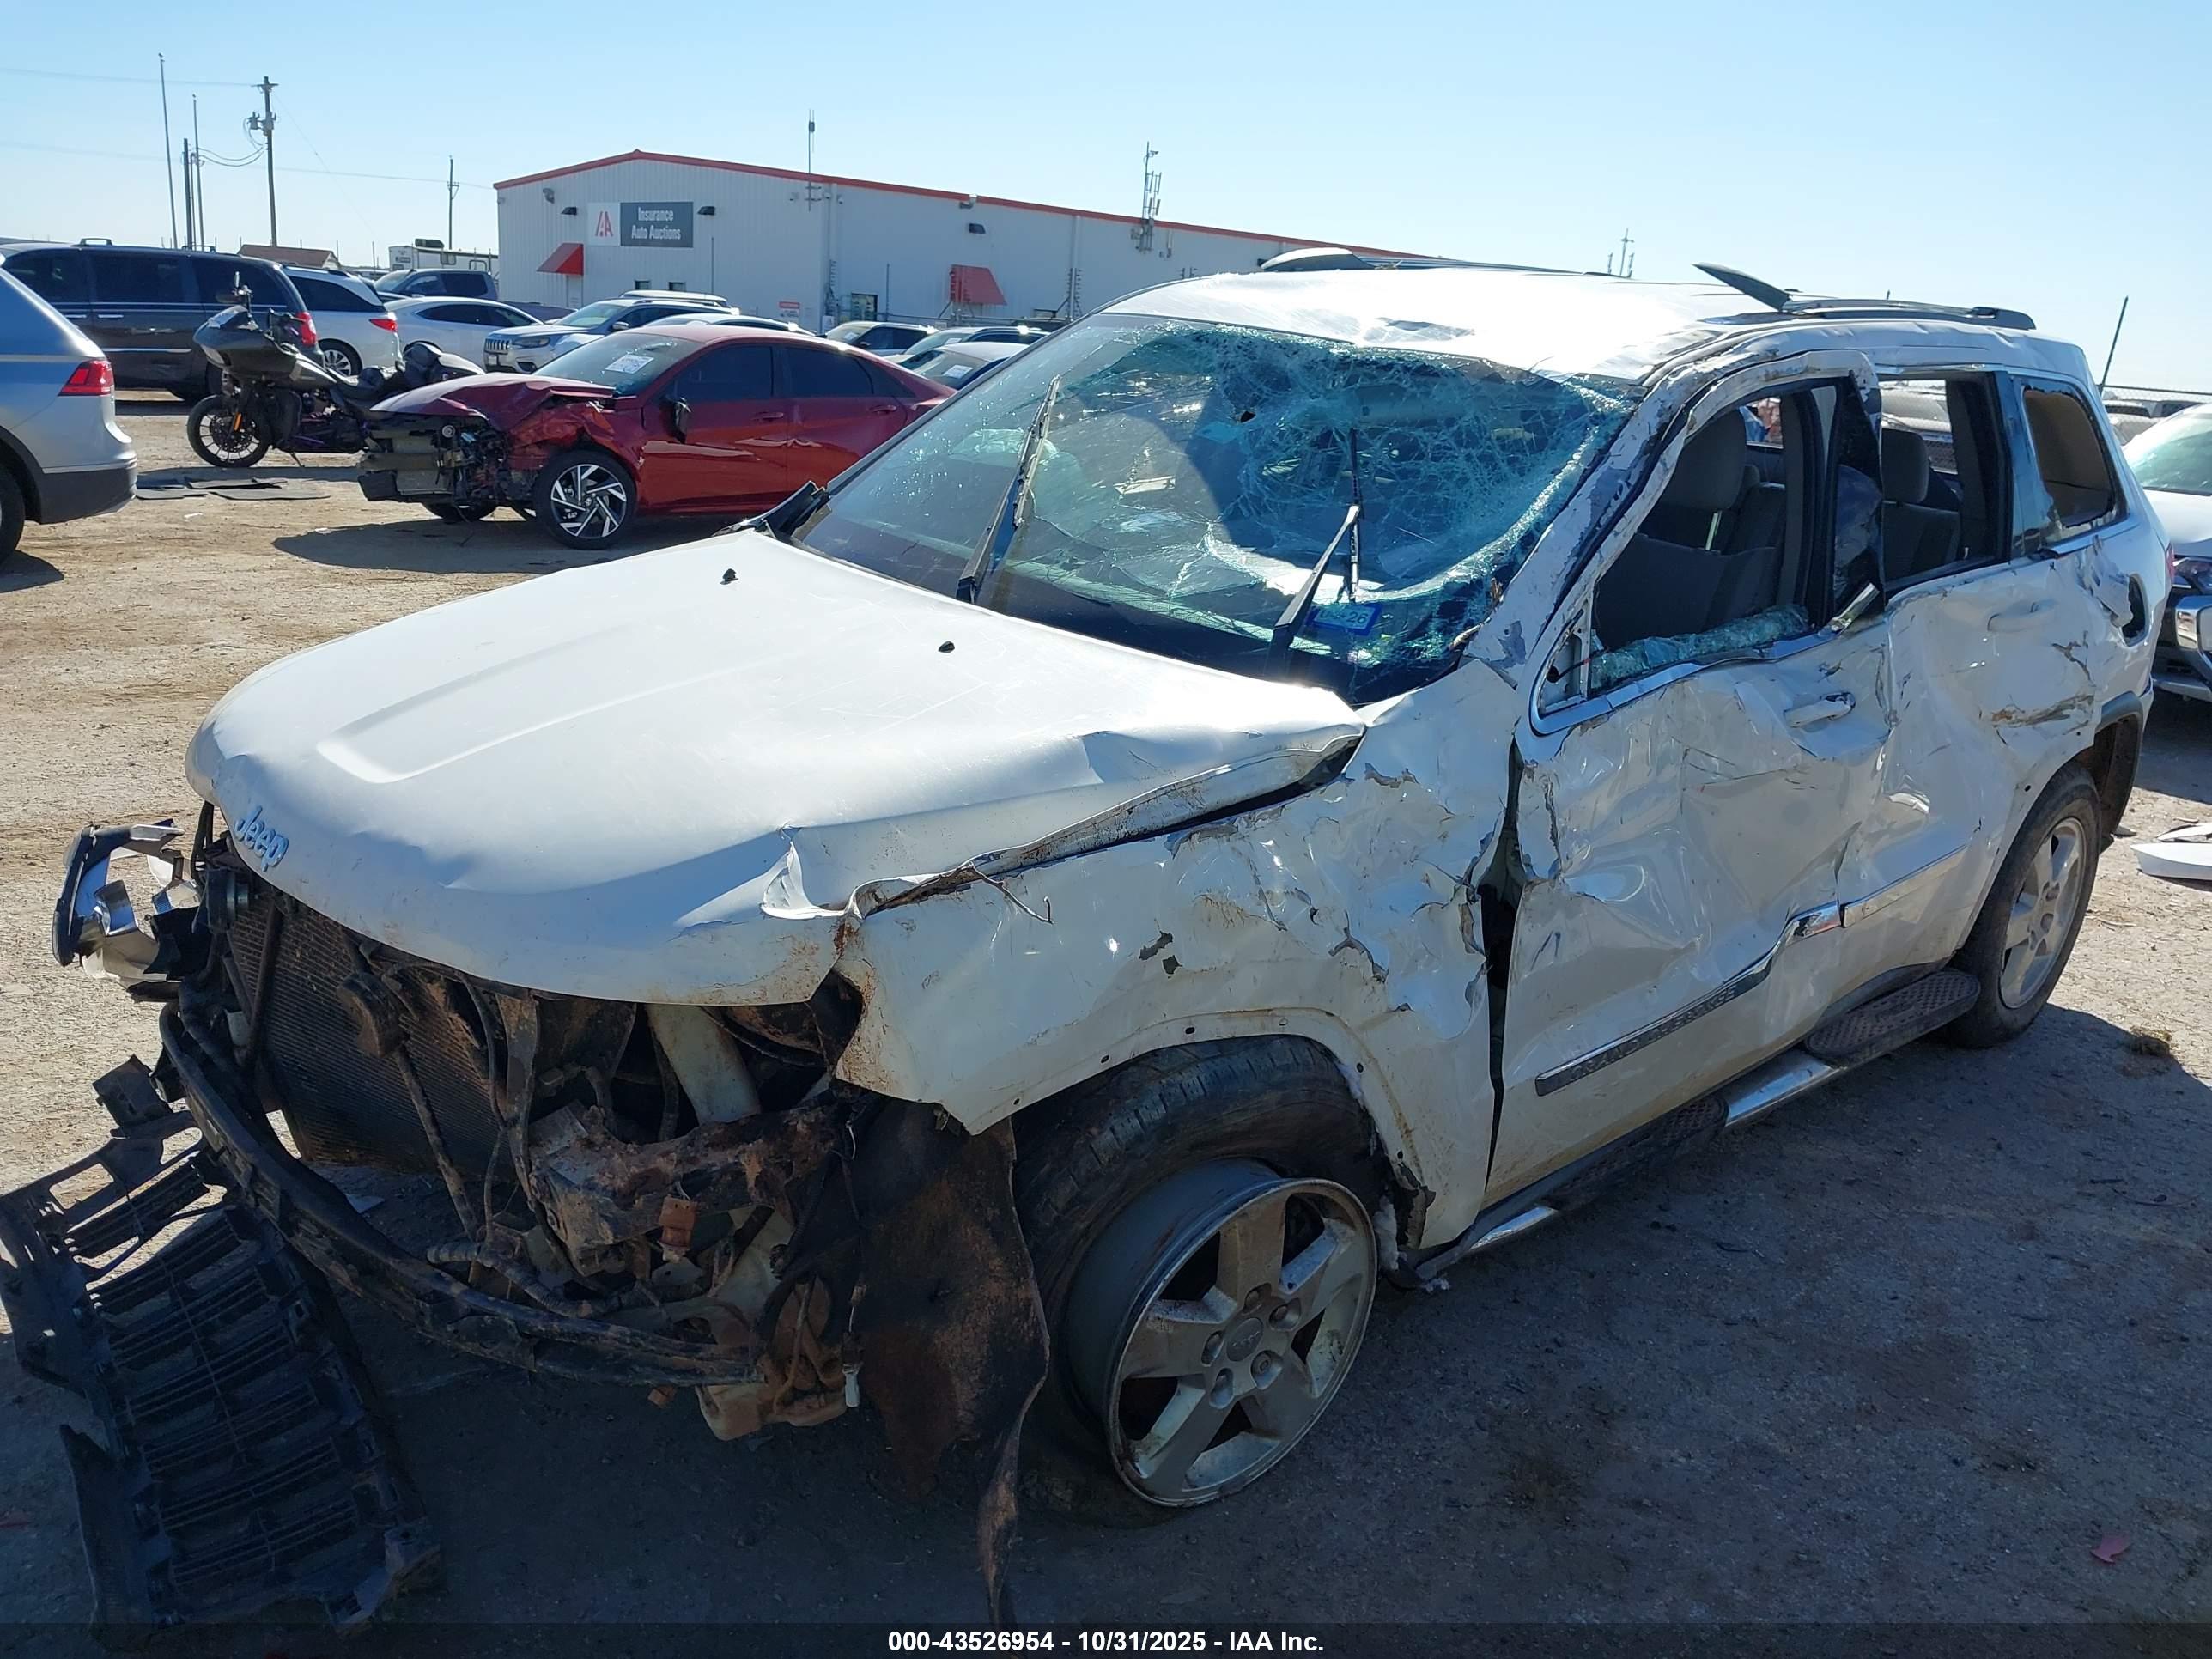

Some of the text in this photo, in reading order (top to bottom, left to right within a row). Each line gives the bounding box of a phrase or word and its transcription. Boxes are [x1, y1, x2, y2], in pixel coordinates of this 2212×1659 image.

[637, 207, 674, 222] Insurance
[631, 225, 681, 240] Auto Auctions
[234, 806, 289, 872] Jeep
